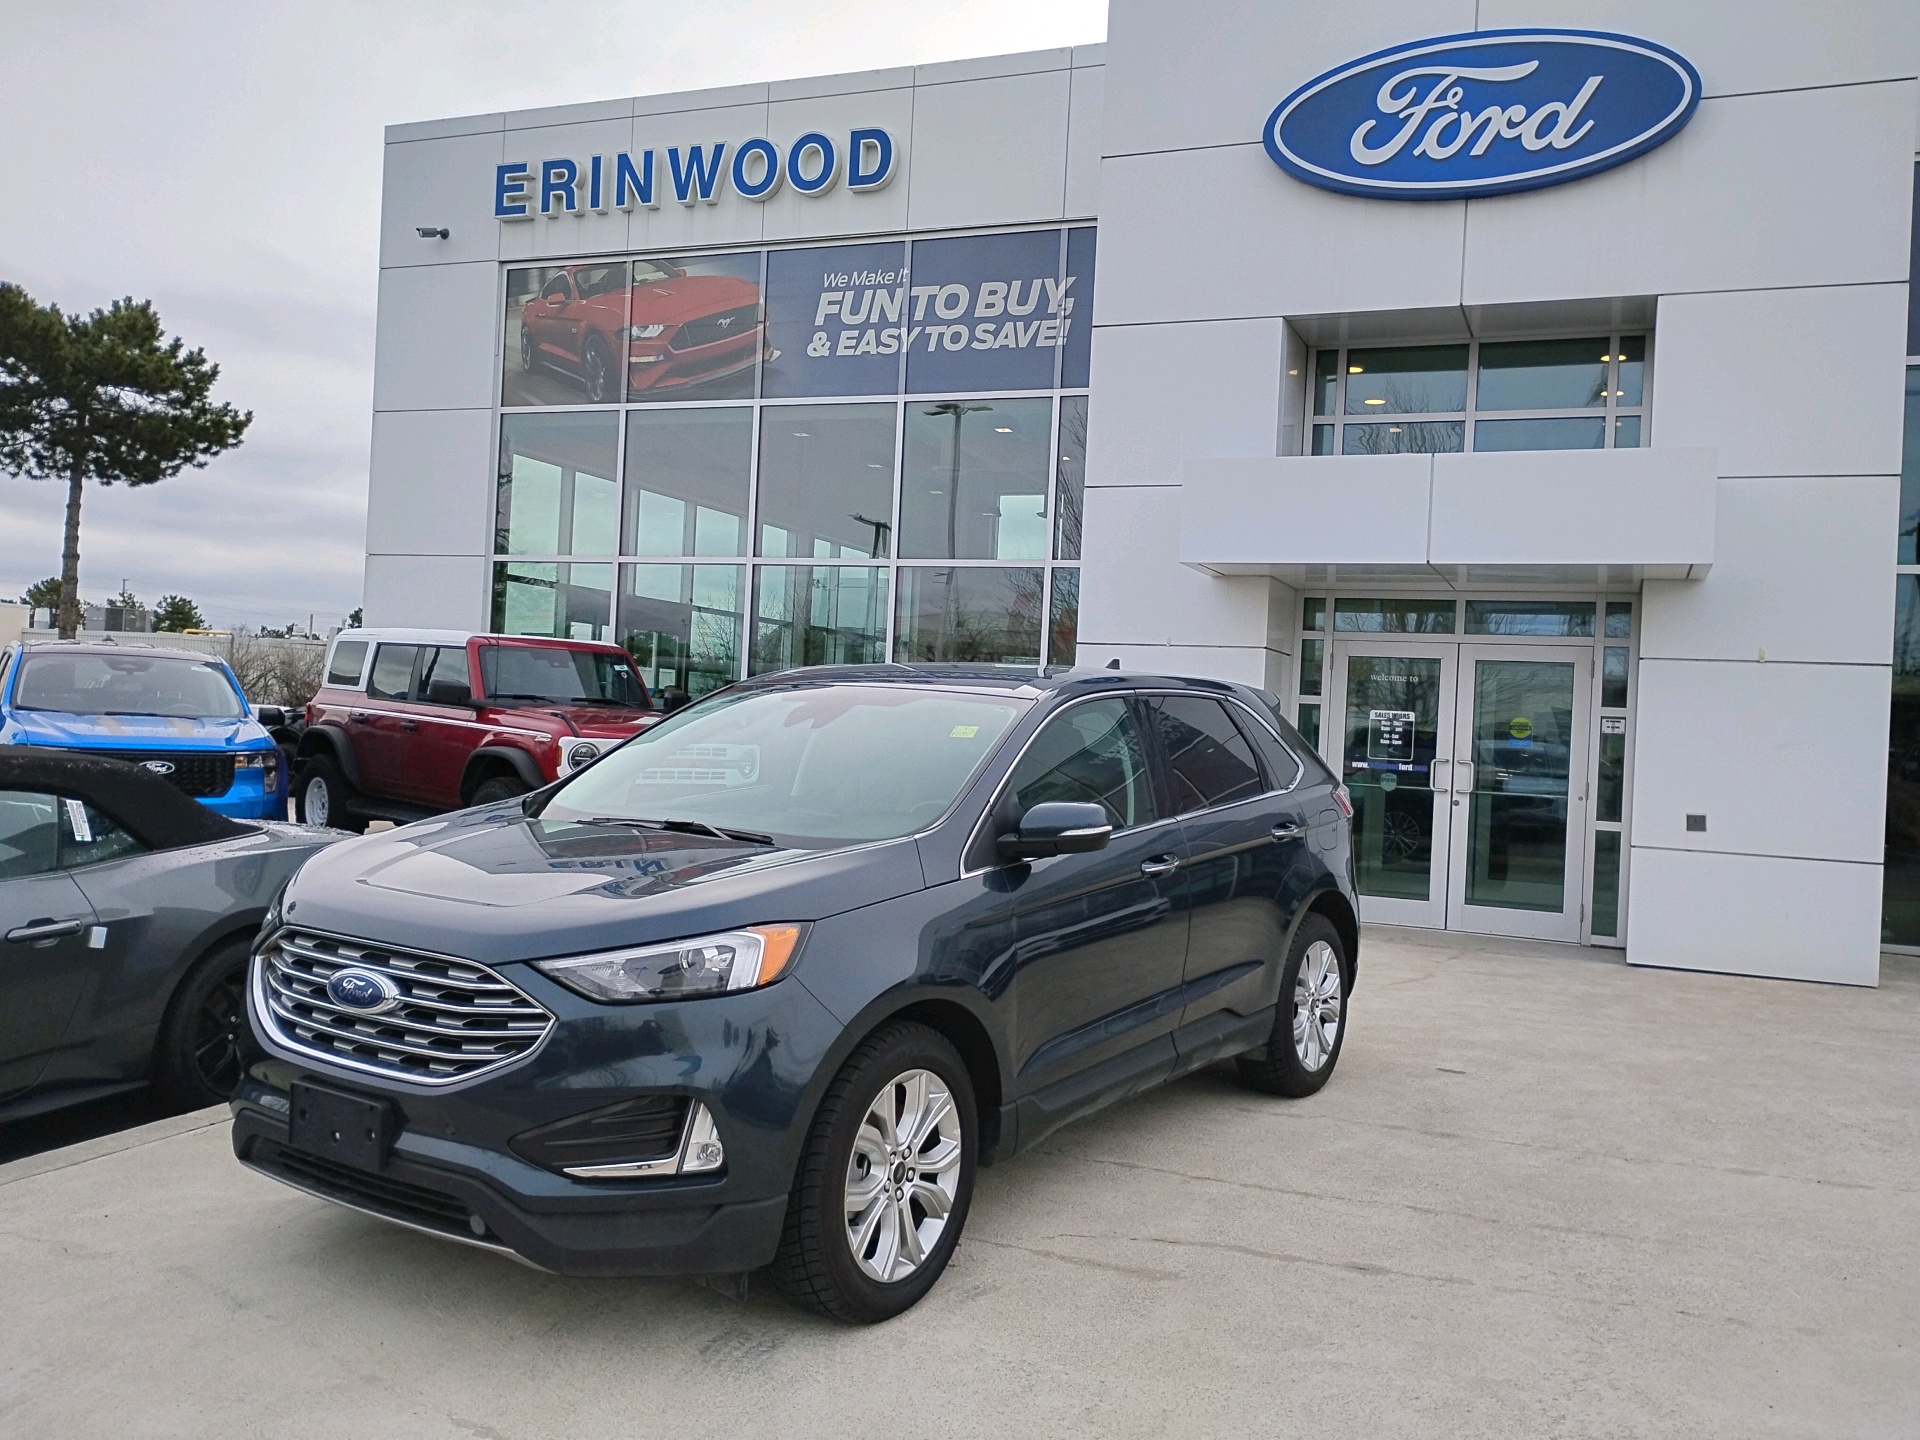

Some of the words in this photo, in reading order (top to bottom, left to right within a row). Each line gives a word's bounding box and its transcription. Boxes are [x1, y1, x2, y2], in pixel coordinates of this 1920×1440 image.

[1350, 60, 1604, 165] Ford
[494, 126, 896, 220] ERINWOOD
[823, 272, 847, 288] We
[851, 269, 894, 287] Make
[897, 267, 909, 283] It
[814, 287, 905, 326] FUN
[910, 283, 970, 321] TO
[806, 331, 831, 357] &
[836, 327, 923, 356] EASY
[924, 324, 970, 352] TO
[970, 319, 1072, 349] SAVE!
[1370, 673, 1407, 682] welcome
[1409, 675, 1419, 683] to
[1374, 711, 1391, 719] SALES
